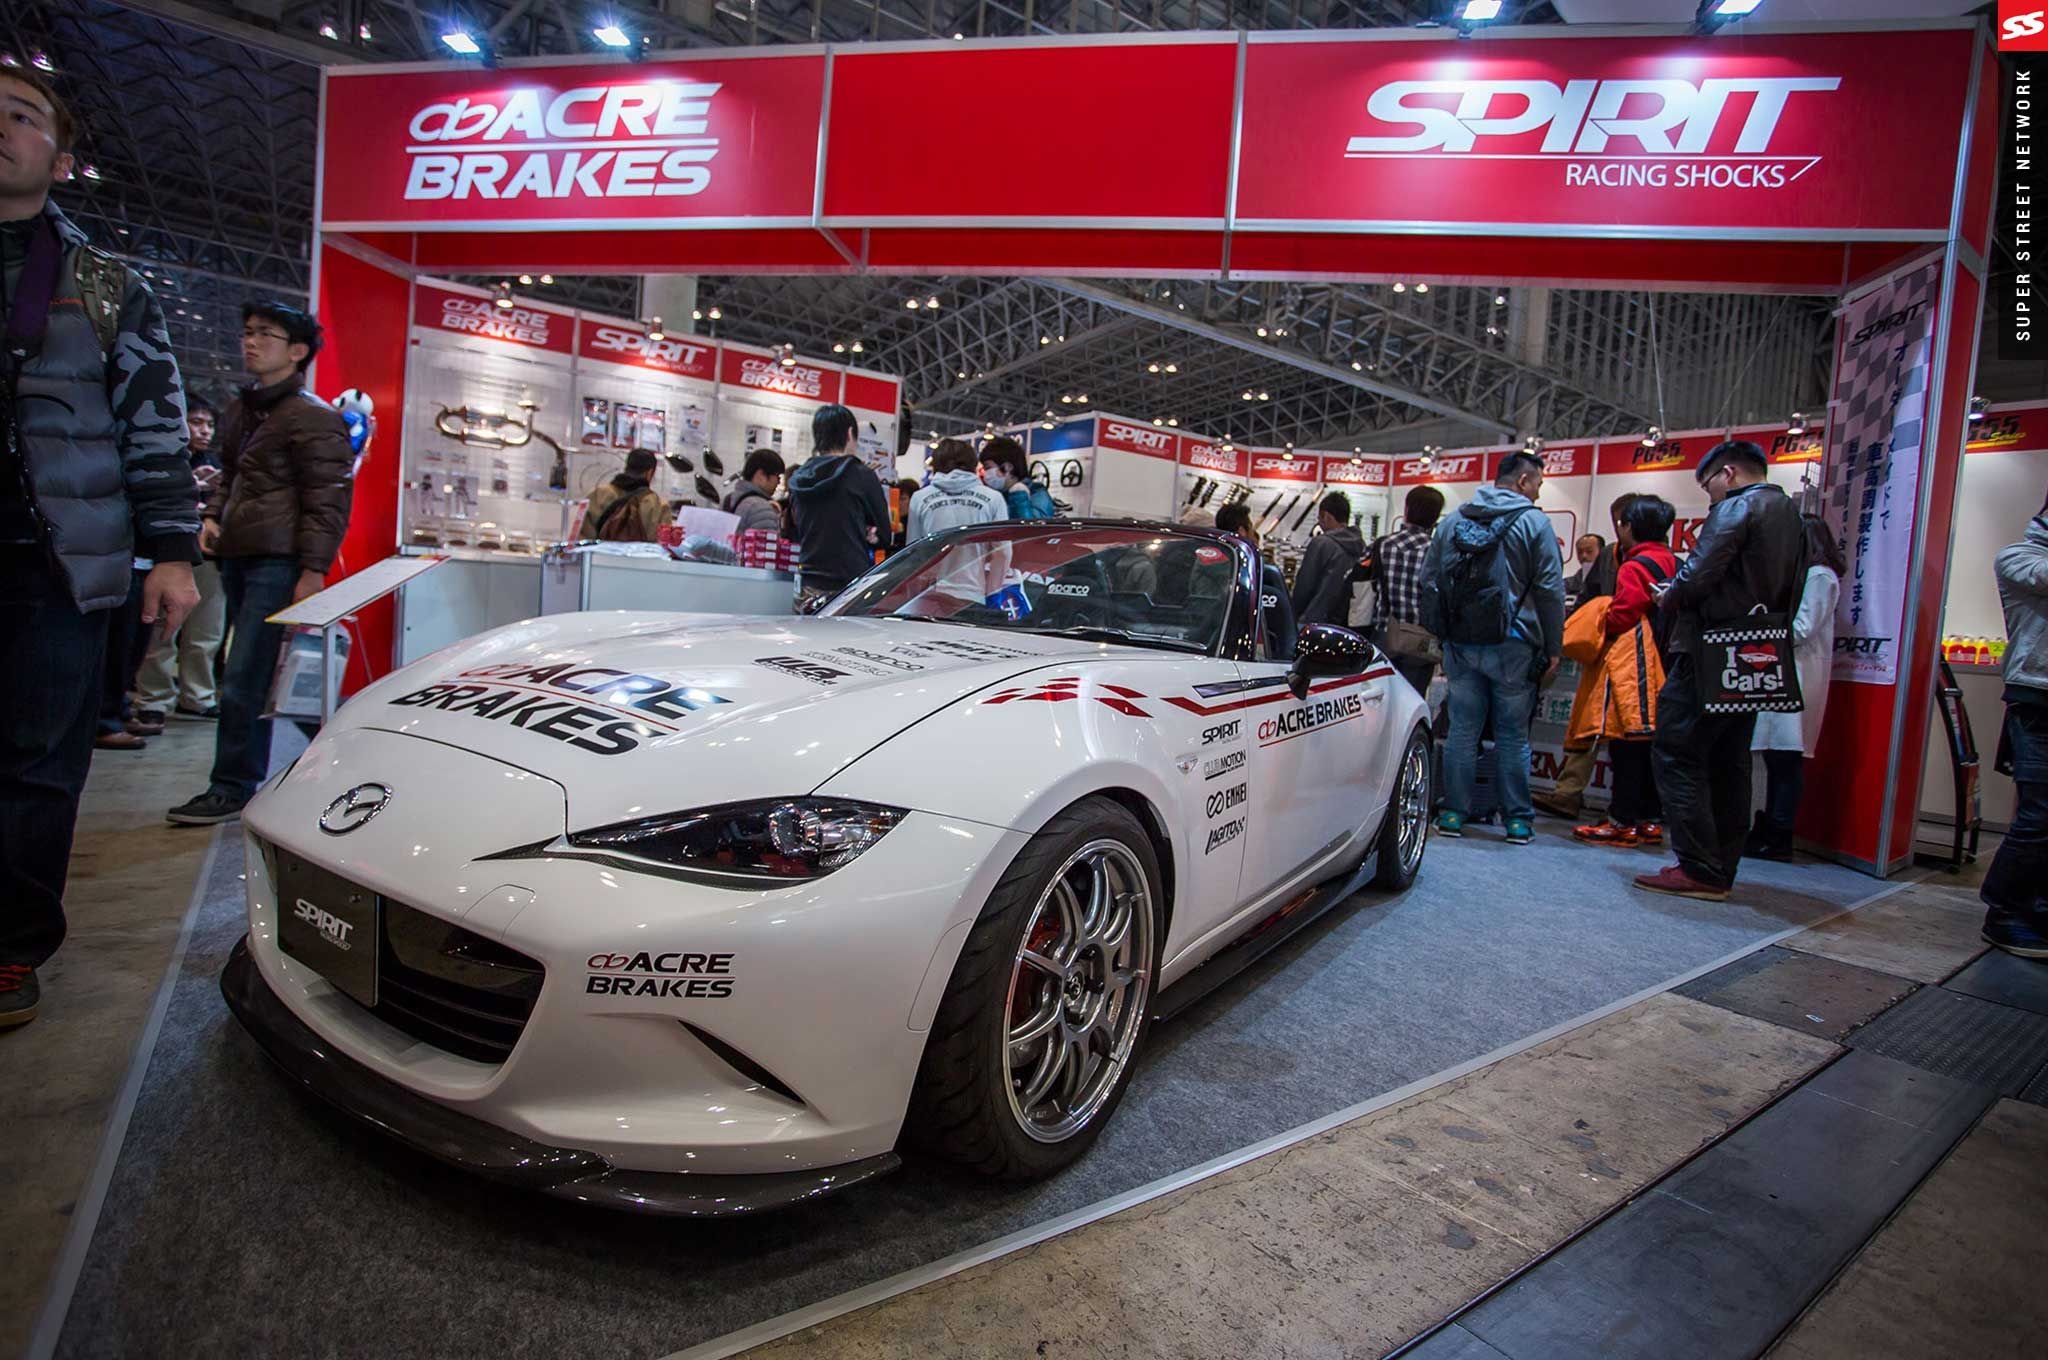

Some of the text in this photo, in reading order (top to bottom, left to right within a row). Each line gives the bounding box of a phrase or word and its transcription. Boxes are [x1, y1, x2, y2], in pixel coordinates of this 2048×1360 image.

[1346, 77, 1842, 153] SPIRIT
[404, 148, 719, 200] BRAKES
[1566, 164, 1785, 188] RACING SHOCKS
[441, 313, 550, 345] BRAKES
[591, 327, 708, 365] SPIRIT
[740, 372, 822, 397] BRAKES
[1105, 423, 1172, 450] SPIRIT
[1191, 455, 1237, 473] BRAKES
[1254, 458, 1316, 472] SPIRIT
[1400, 457, 1477, 477] SPIRIT
[1326, 471, 1385, 484] BRAKES
[1726, 646, 1737, 668] I
[1833, 636, 1892, 654] PIRIT
[1722, 665, 1784, 691] Cars!
[388, 684, 667, 756] BRAKES
[1316, 694, 1362, 725] BRAKES
[1201, 718, 1242, 746] SPIRIT
[294, 899, 354, 942] SPIRIT
[586, 976, 735, 998] BRAKES
